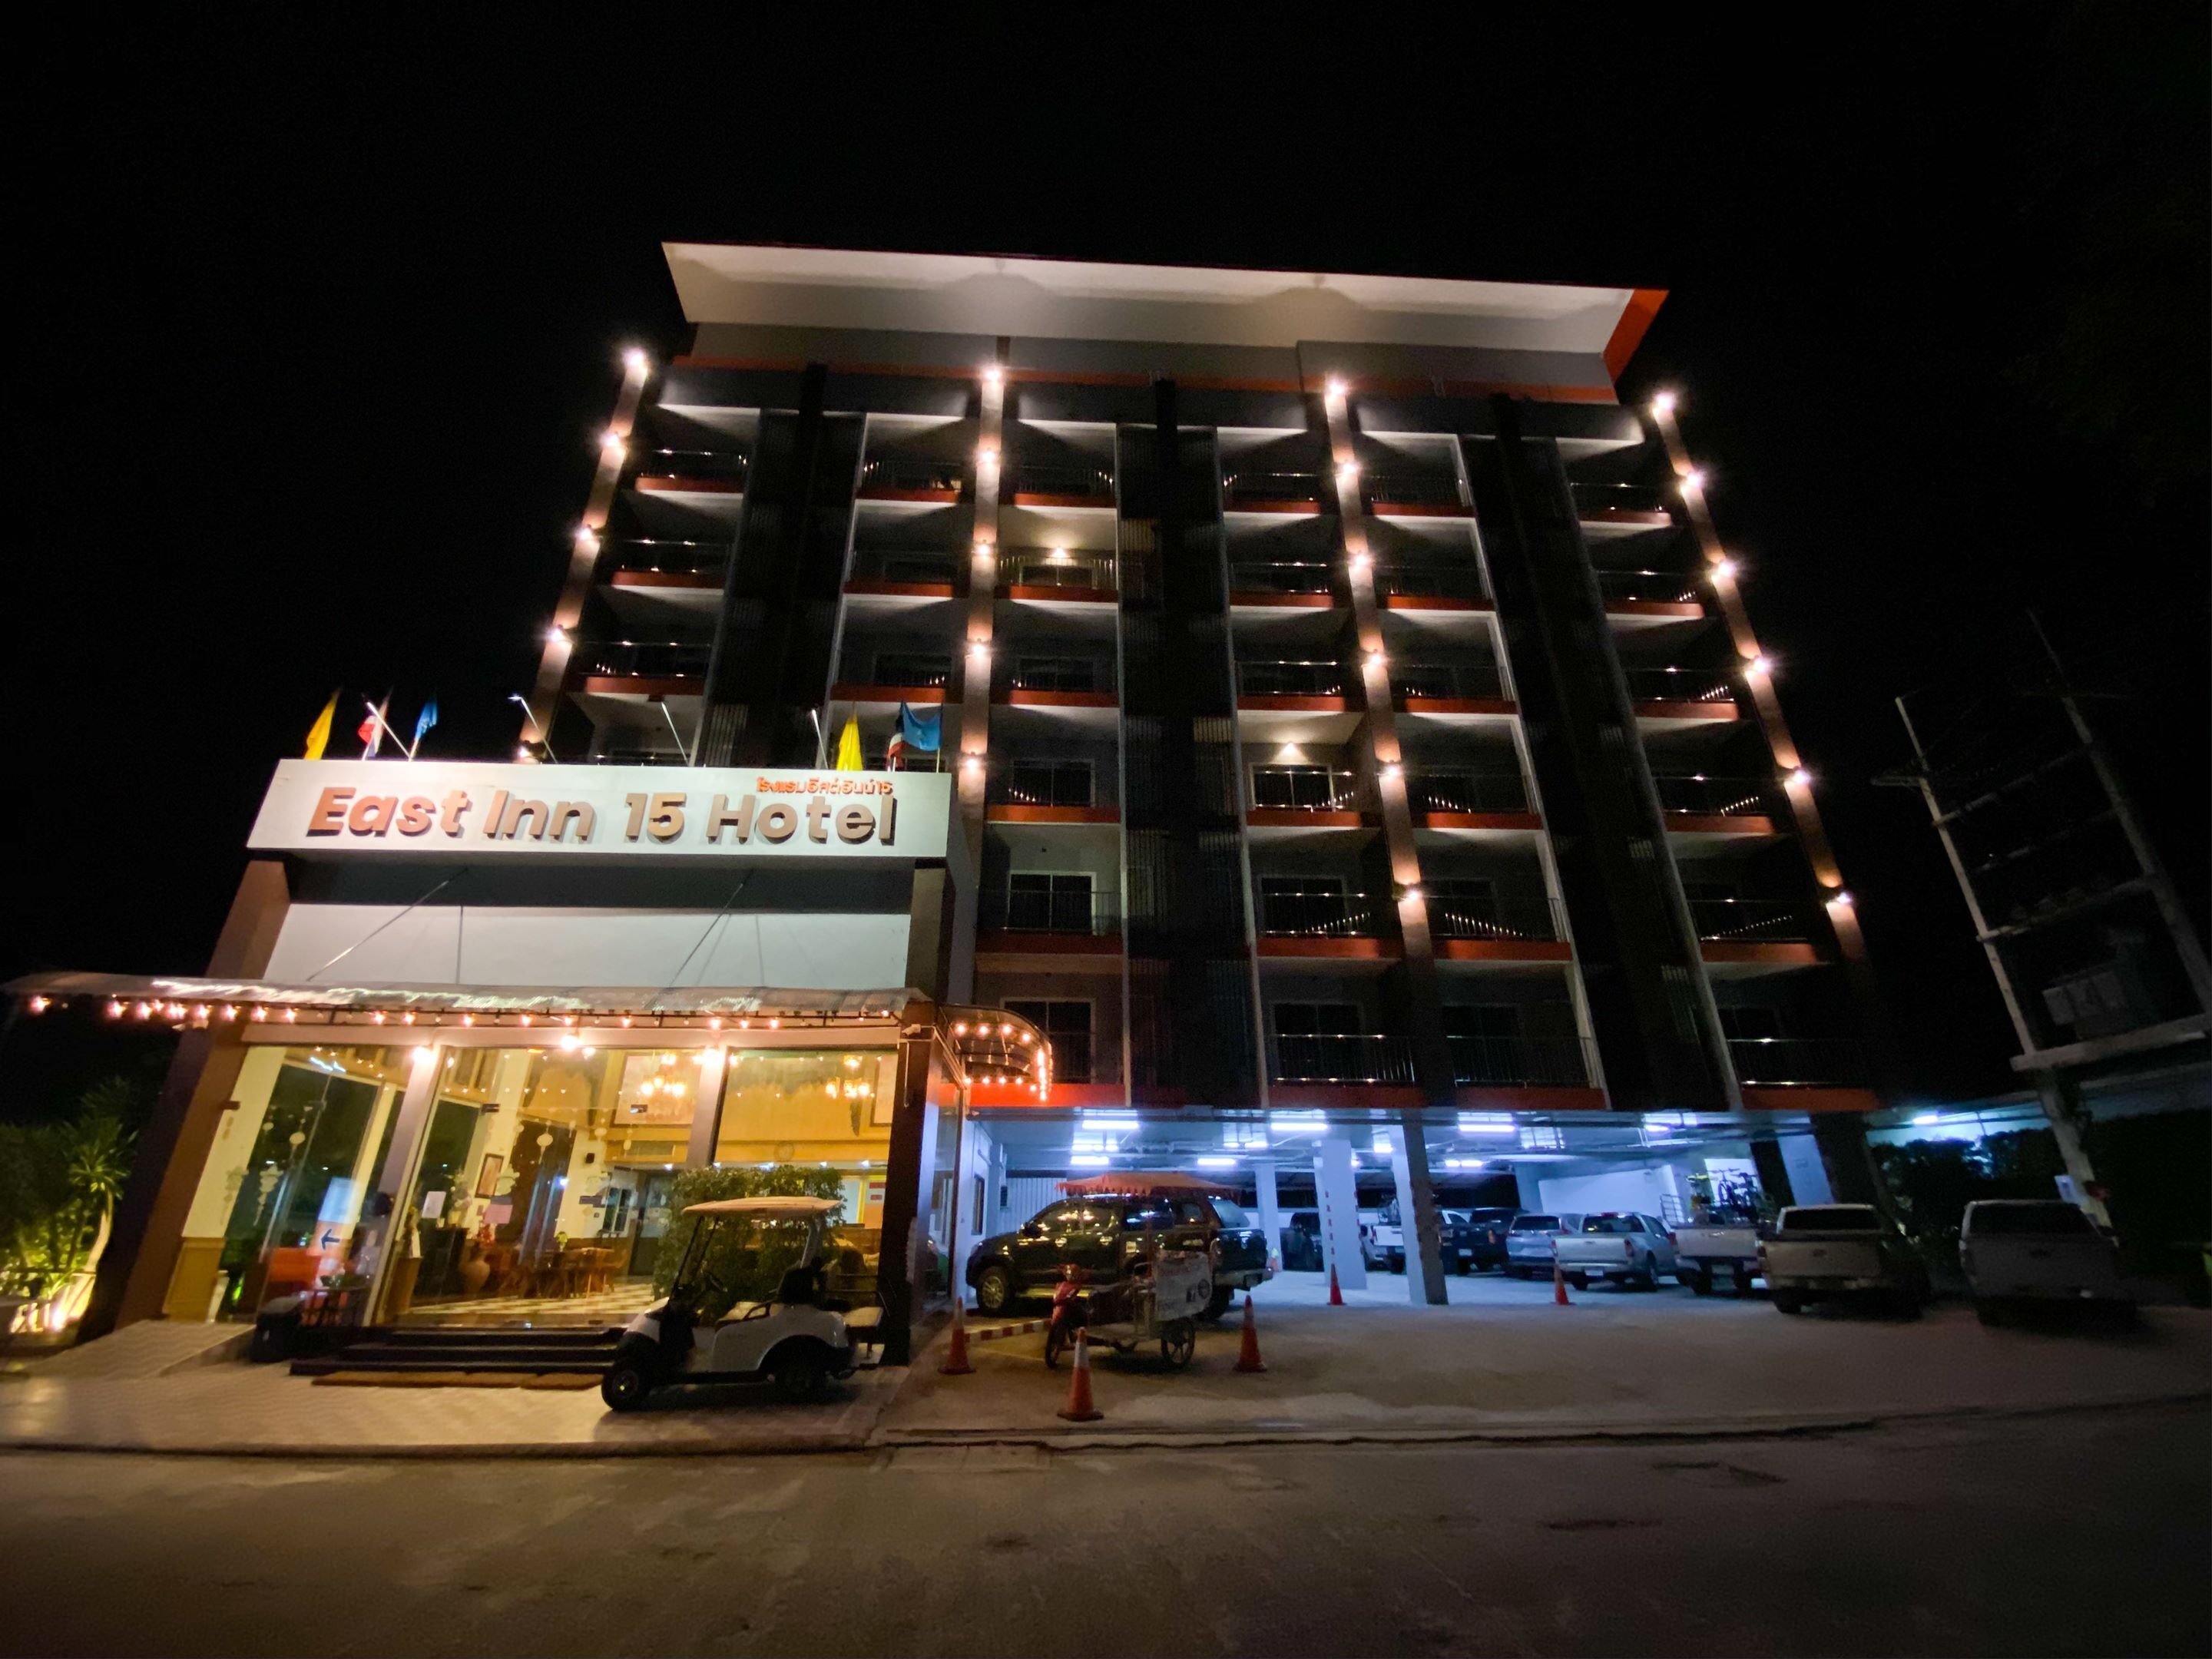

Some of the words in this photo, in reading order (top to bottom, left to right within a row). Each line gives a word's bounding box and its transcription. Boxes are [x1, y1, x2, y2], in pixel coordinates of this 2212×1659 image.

[306, 787, 470, 838] East
[483, 790, 594, 840] Inn
[625, 793, 687, 843] 15
[706, 794, 897, 846] Hotel
